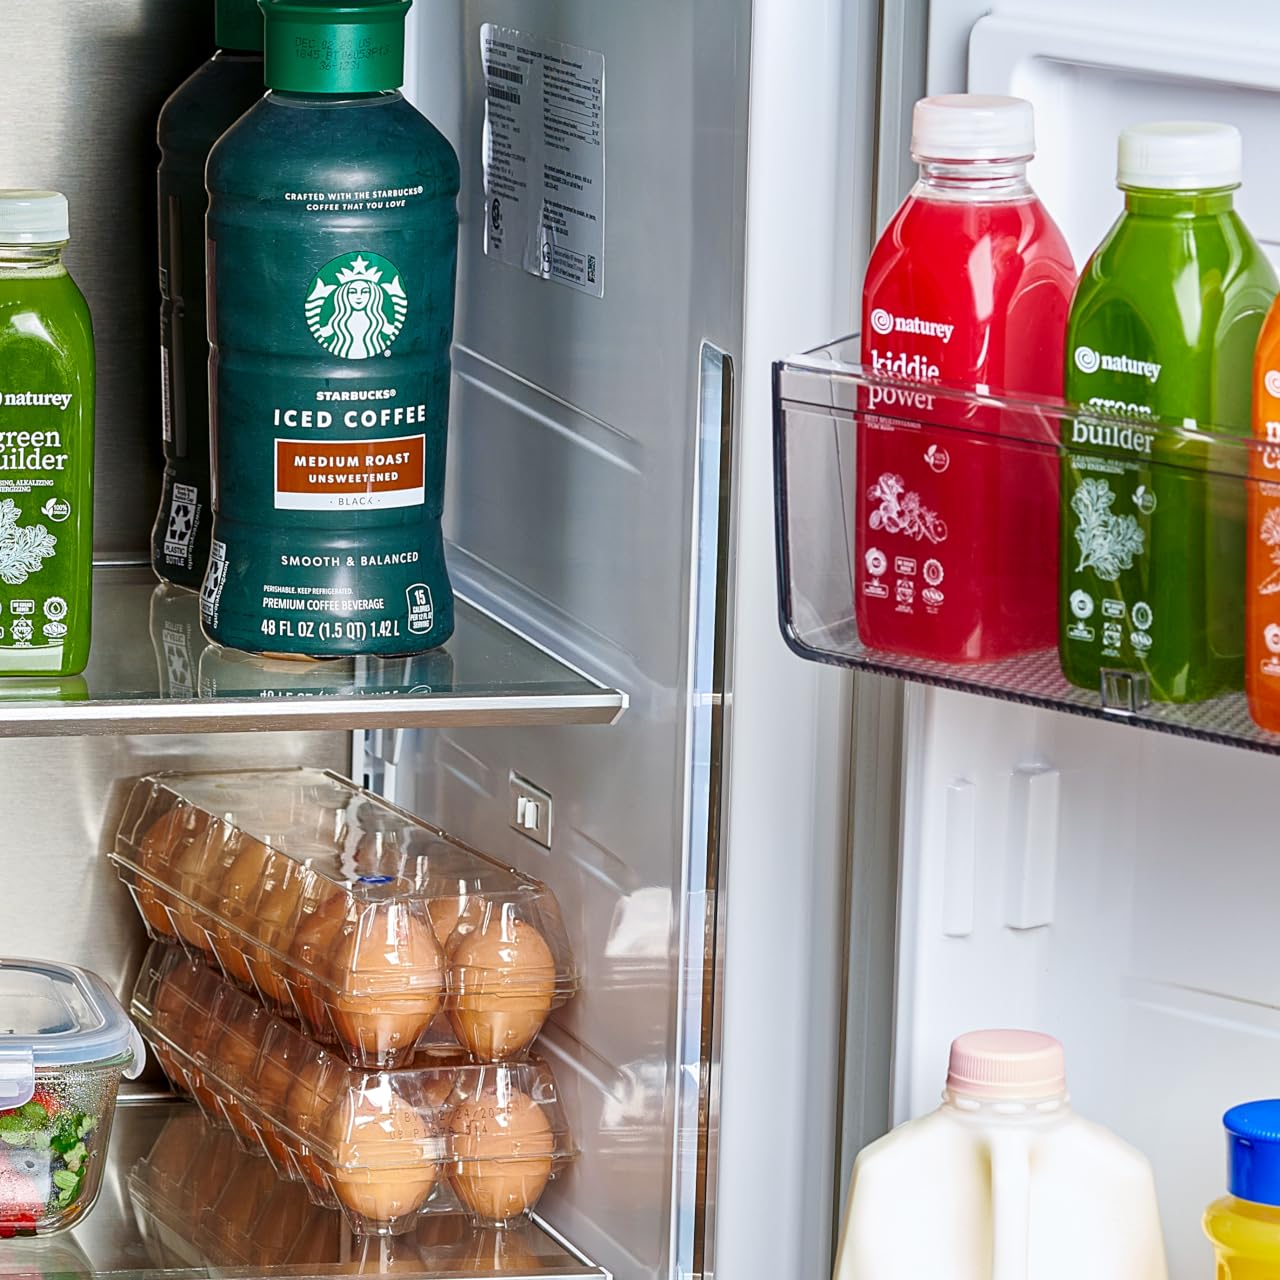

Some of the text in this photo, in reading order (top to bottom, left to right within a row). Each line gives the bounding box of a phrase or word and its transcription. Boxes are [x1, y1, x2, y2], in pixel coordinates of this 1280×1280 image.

[284, 192, 325, 201] CRAFTED
[327, 192, 352, 201] WITH
[354, 191, 370, 200] THE
[306, 199, 406, 211] COFFEE THAT YOU LOVE
[894, 316, 955, 344] naturey
[1101, 354, 1162, 383] naturey
[4, 390, 73, 411] naturey
[867, 384, 937, 411] power
[273, 404, 427, 428] ICED COFFEE
[293, 452, 411, 468] MEDIUM ROAST
[308, 471, 400, 484] UNSWEETENED
[338, 496, 374, 506] BLACK
[281, 551, 419, 567] SMOOTH & BALANCED
[213, 560, 230, 630] how2recycle.info
[263, 584, 354, 595] PERISHABLE. KEEP REFRIGERATED.
[414, 589, 426, 605] 15
[262, 597, 385, 611] PREMIUM COFFEE BEVERAGE
[261, 619, 400, 641] 48 FL OZ (1.5 QT) 1.42 L
